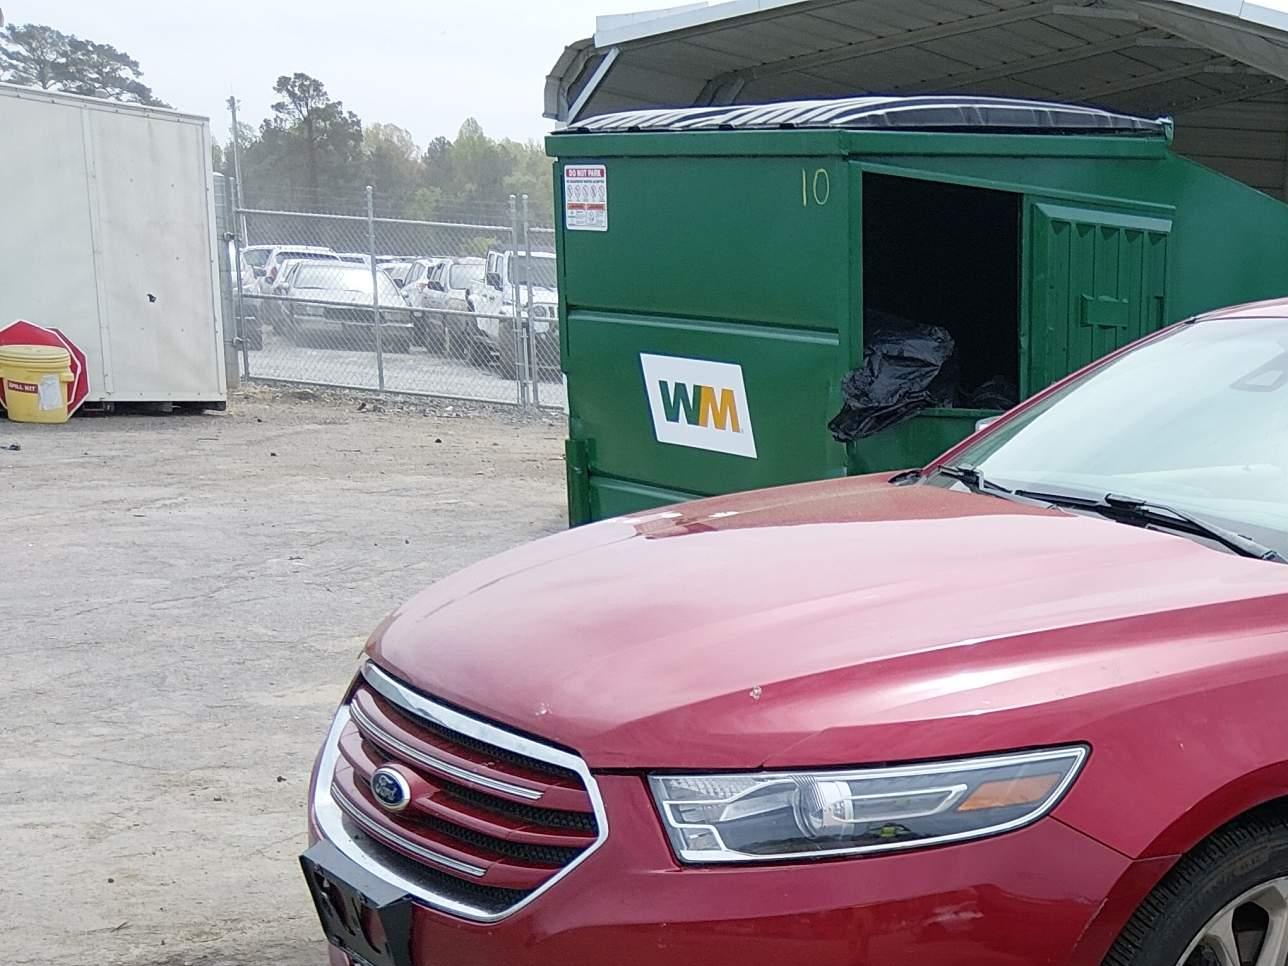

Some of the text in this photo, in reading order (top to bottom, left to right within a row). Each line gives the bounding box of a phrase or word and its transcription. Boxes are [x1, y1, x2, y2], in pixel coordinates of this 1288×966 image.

[802, 168, 830, 207] 10
[658, 380, 742, 433] WM
[374, 774, 400, 801] Ford
